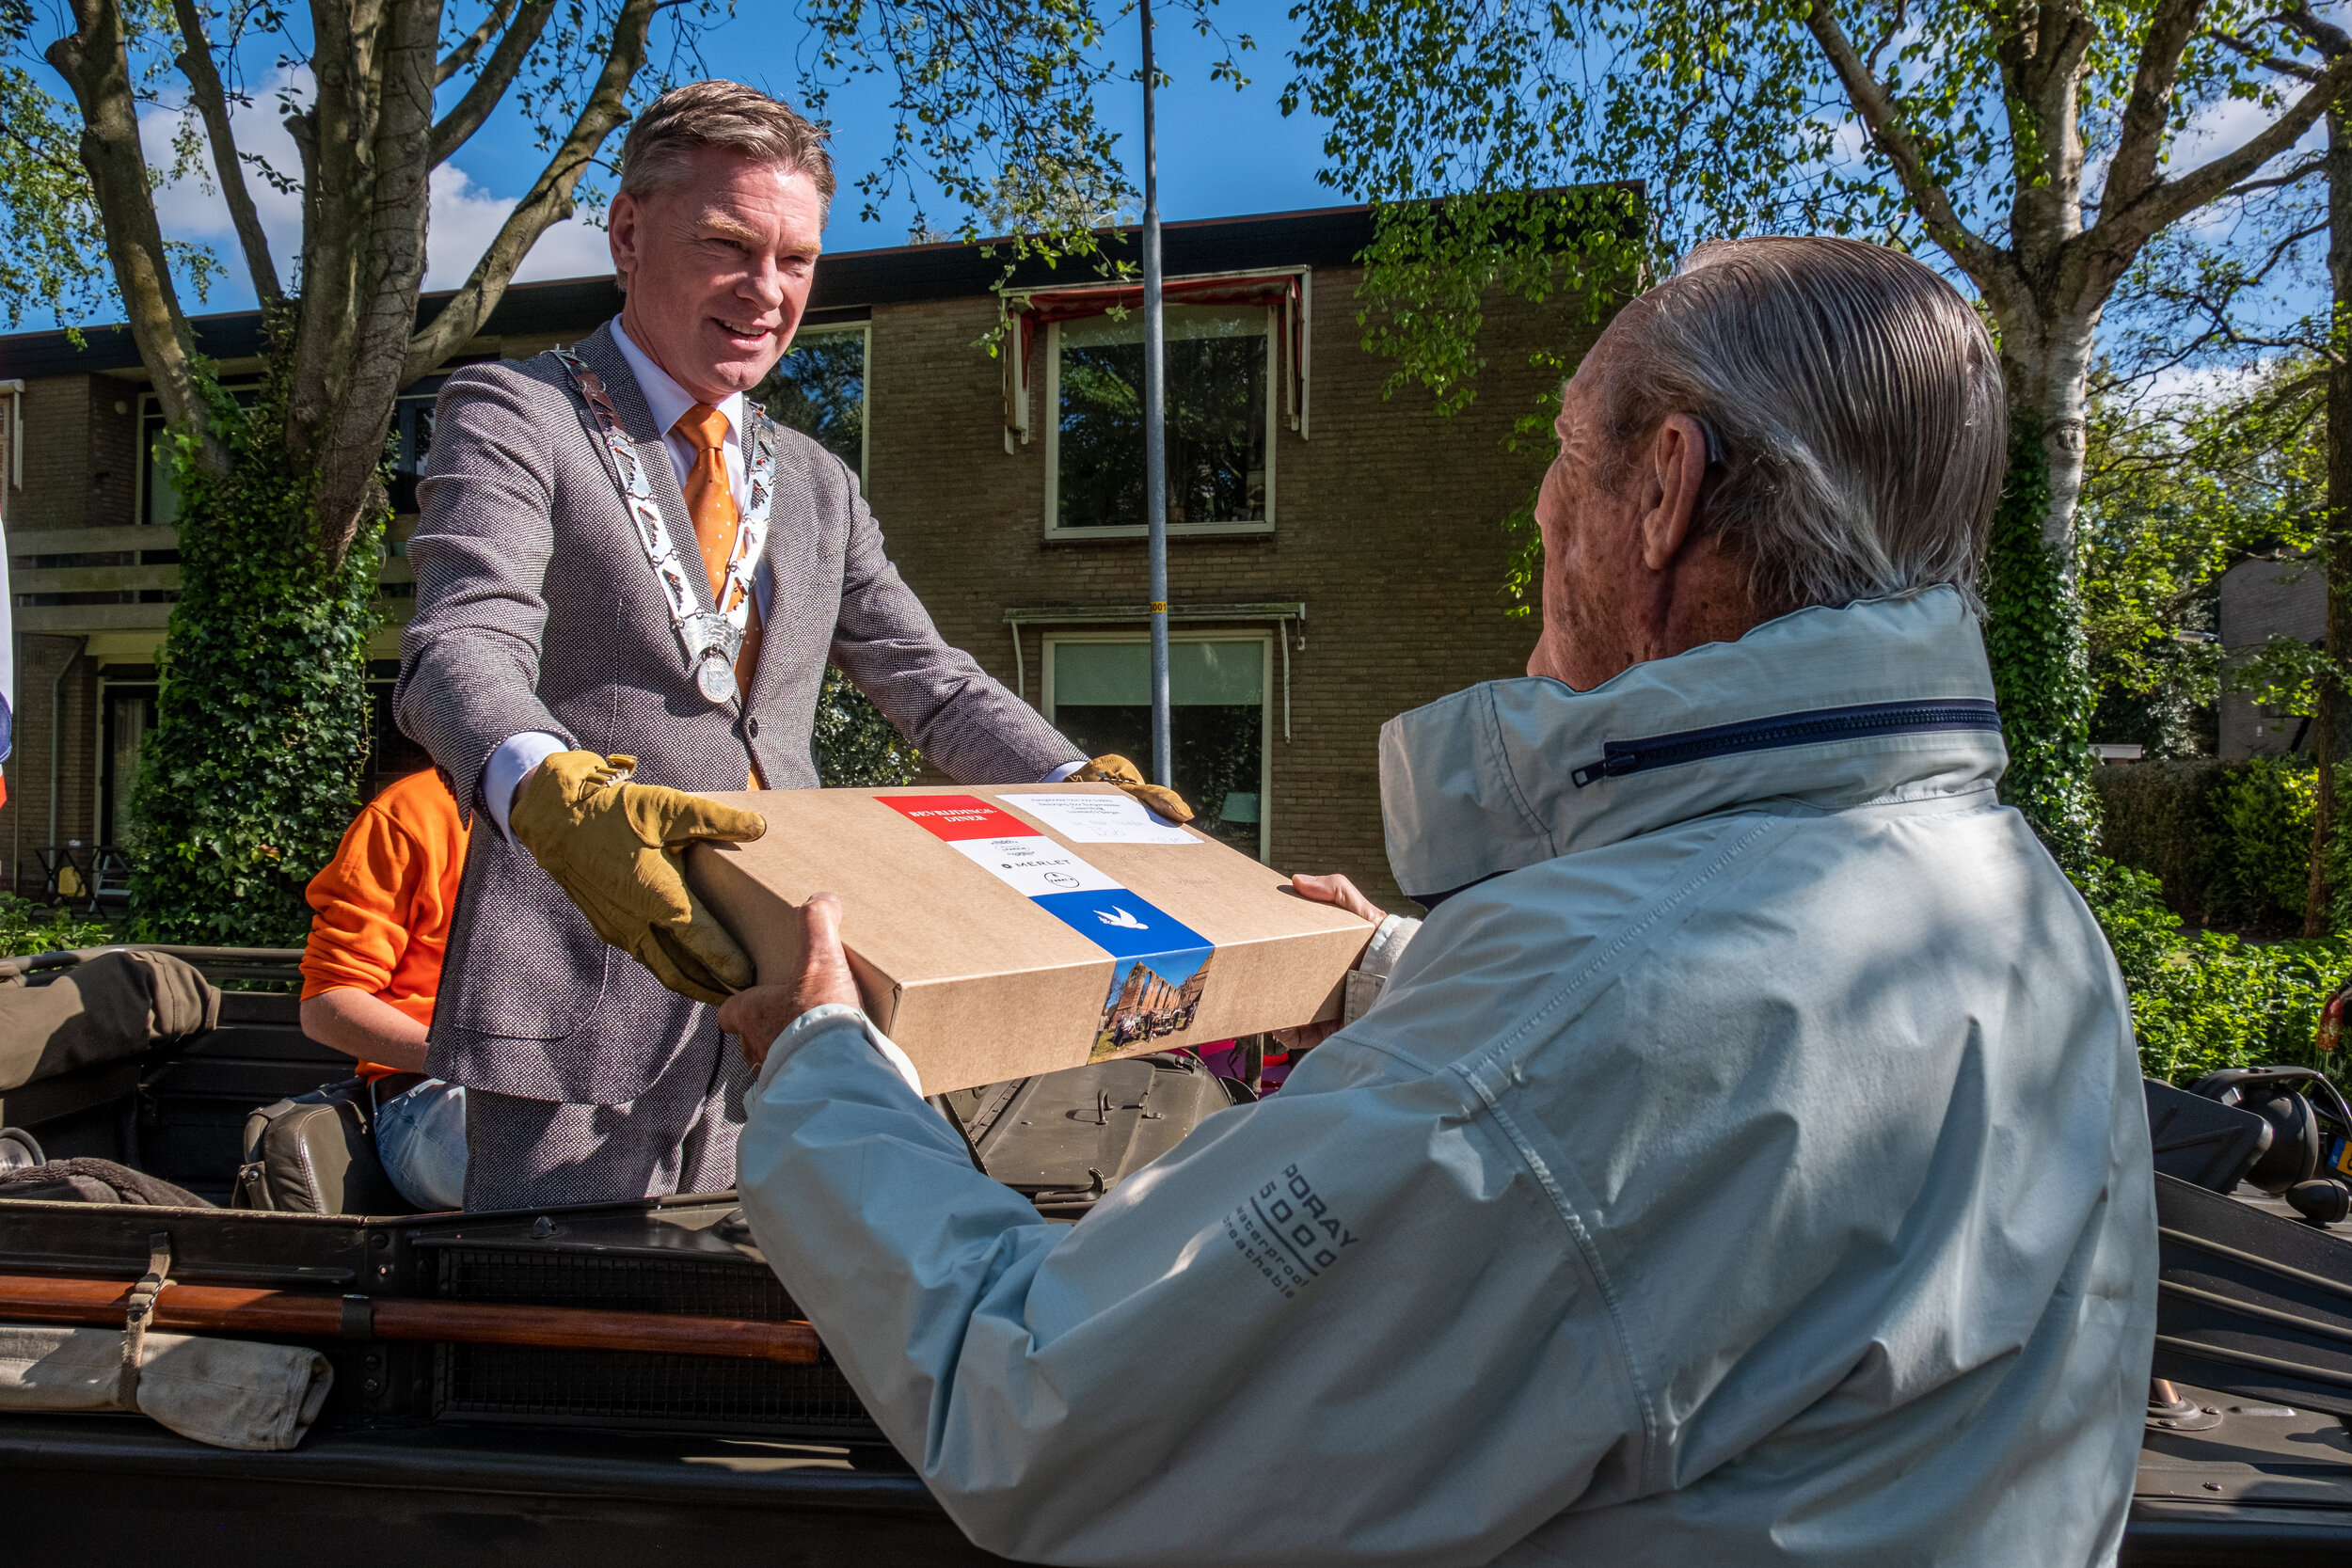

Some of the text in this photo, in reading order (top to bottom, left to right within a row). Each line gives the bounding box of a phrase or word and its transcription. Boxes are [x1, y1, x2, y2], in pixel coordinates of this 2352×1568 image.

[1151, 603, 1167, 611] 001
[1236, 1205, 1310, 1288] waterproof
[1260, 1180, 1337, 1268] 5000
[1282, 1163, 1359, 1248] PORAY
